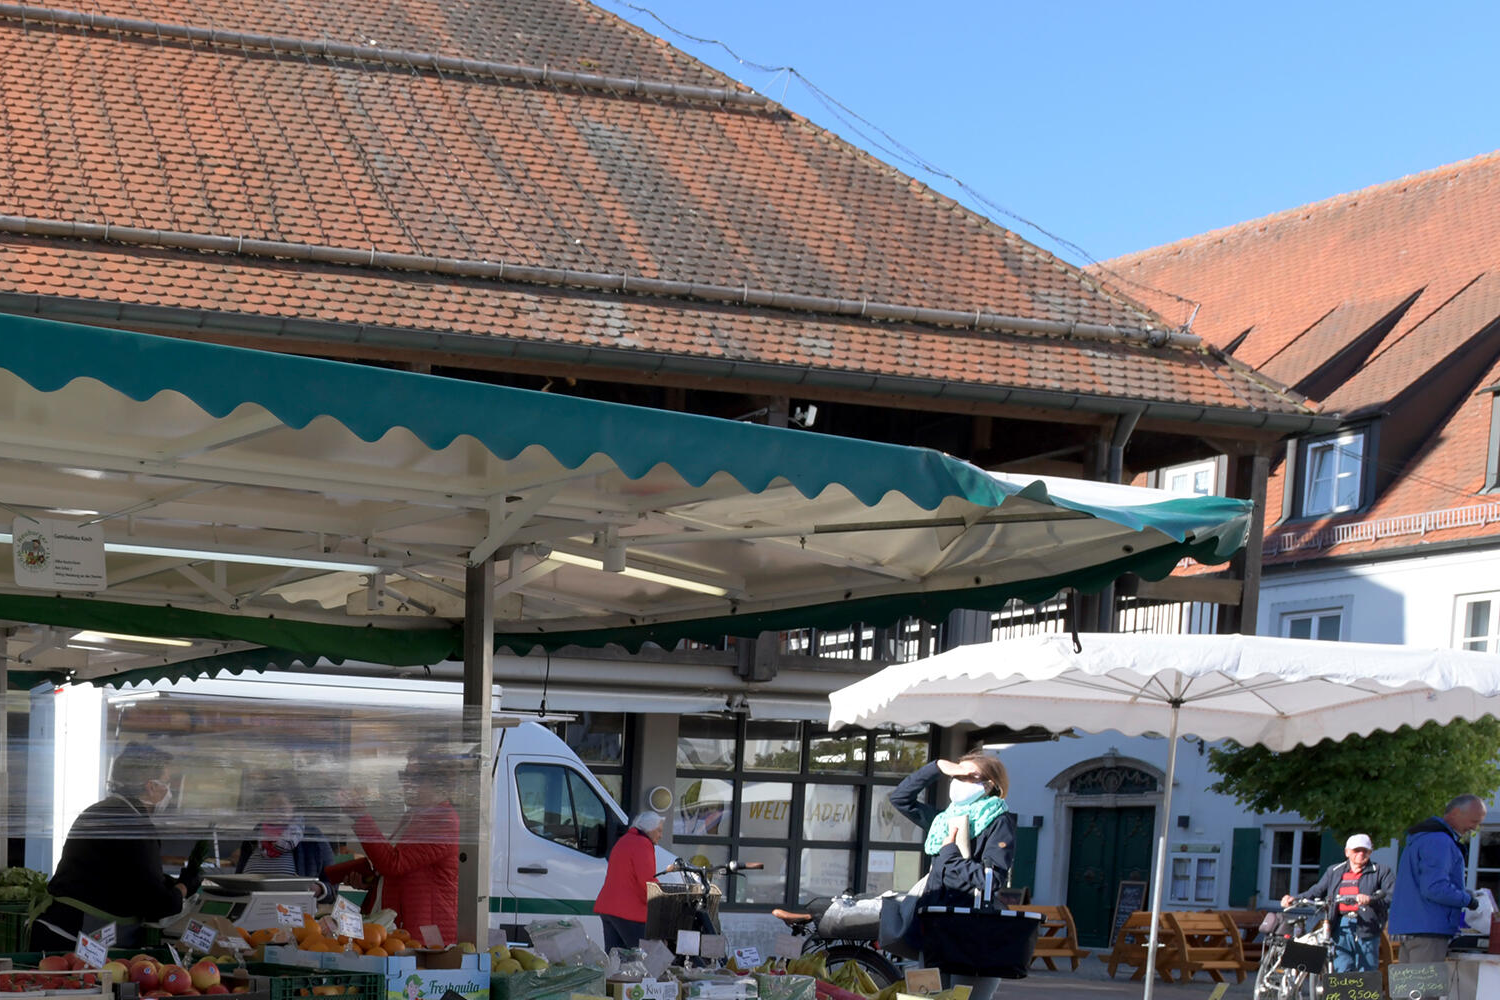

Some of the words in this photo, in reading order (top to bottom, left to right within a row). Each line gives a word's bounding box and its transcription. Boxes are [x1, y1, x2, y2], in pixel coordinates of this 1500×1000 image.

[749, 800, 791, 820] WELT
[805, 802, 856, 822] LADEN
[645, 985, 662, 995] Kiwi
